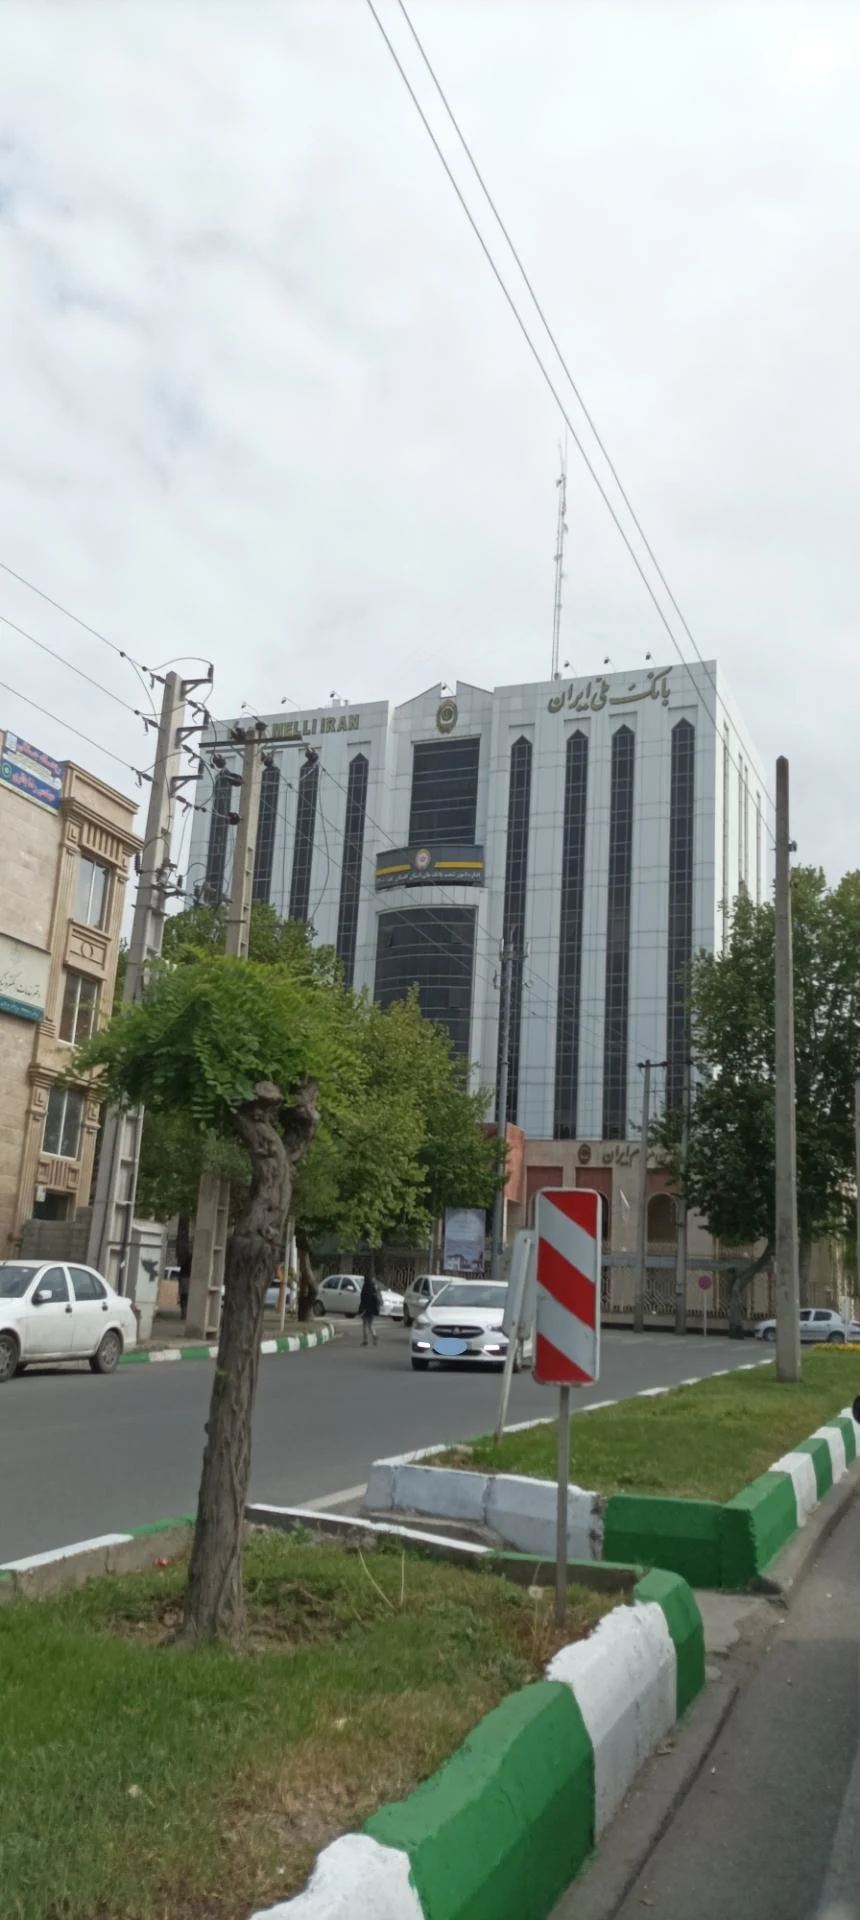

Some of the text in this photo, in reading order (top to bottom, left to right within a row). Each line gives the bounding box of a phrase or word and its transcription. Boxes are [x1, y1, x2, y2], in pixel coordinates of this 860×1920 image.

[547, 682, 591, 713] ایران
[608, 666, 672, 706] بانک
[271, 718, 317, 737] MELLI
[320, 714, 360, 734] IRAN
[602, 1144, 630, 1166] ایران
